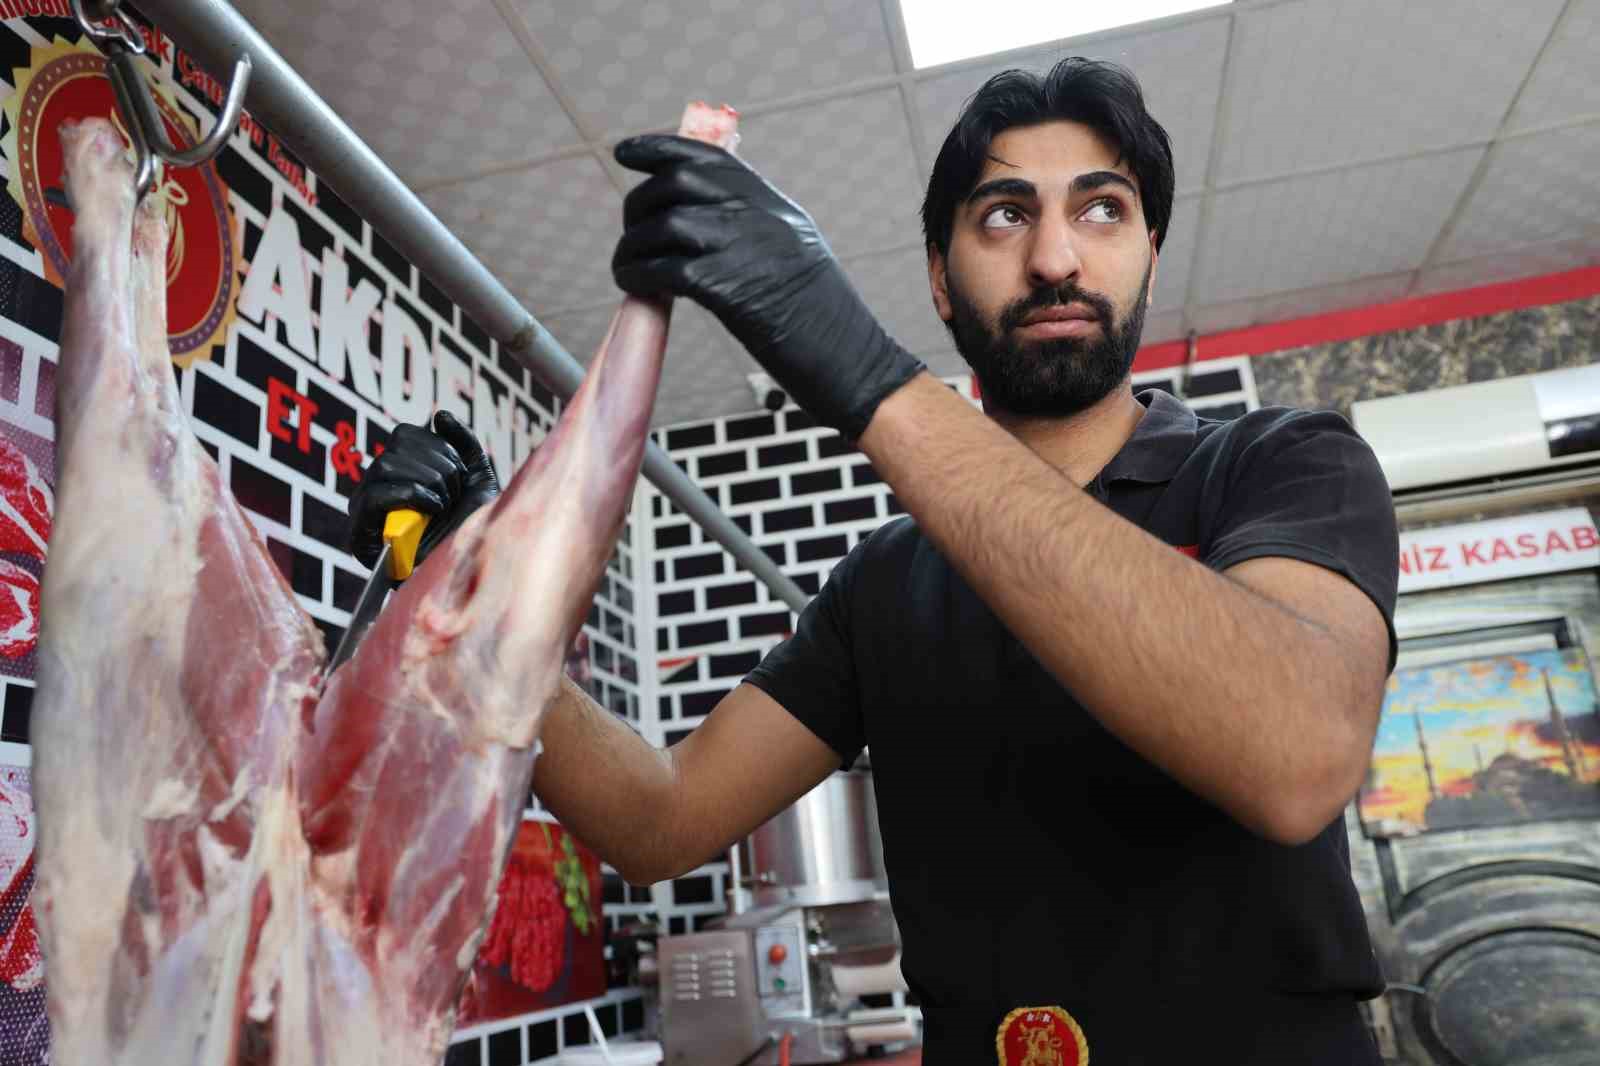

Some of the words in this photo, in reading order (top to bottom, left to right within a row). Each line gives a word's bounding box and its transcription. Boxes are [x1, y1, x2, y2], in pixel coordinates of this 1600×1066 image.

[237, 207, 548, 489] AKDENİ
[267, 376, 319, 454] ET
[331, 420, 363, 484] &
